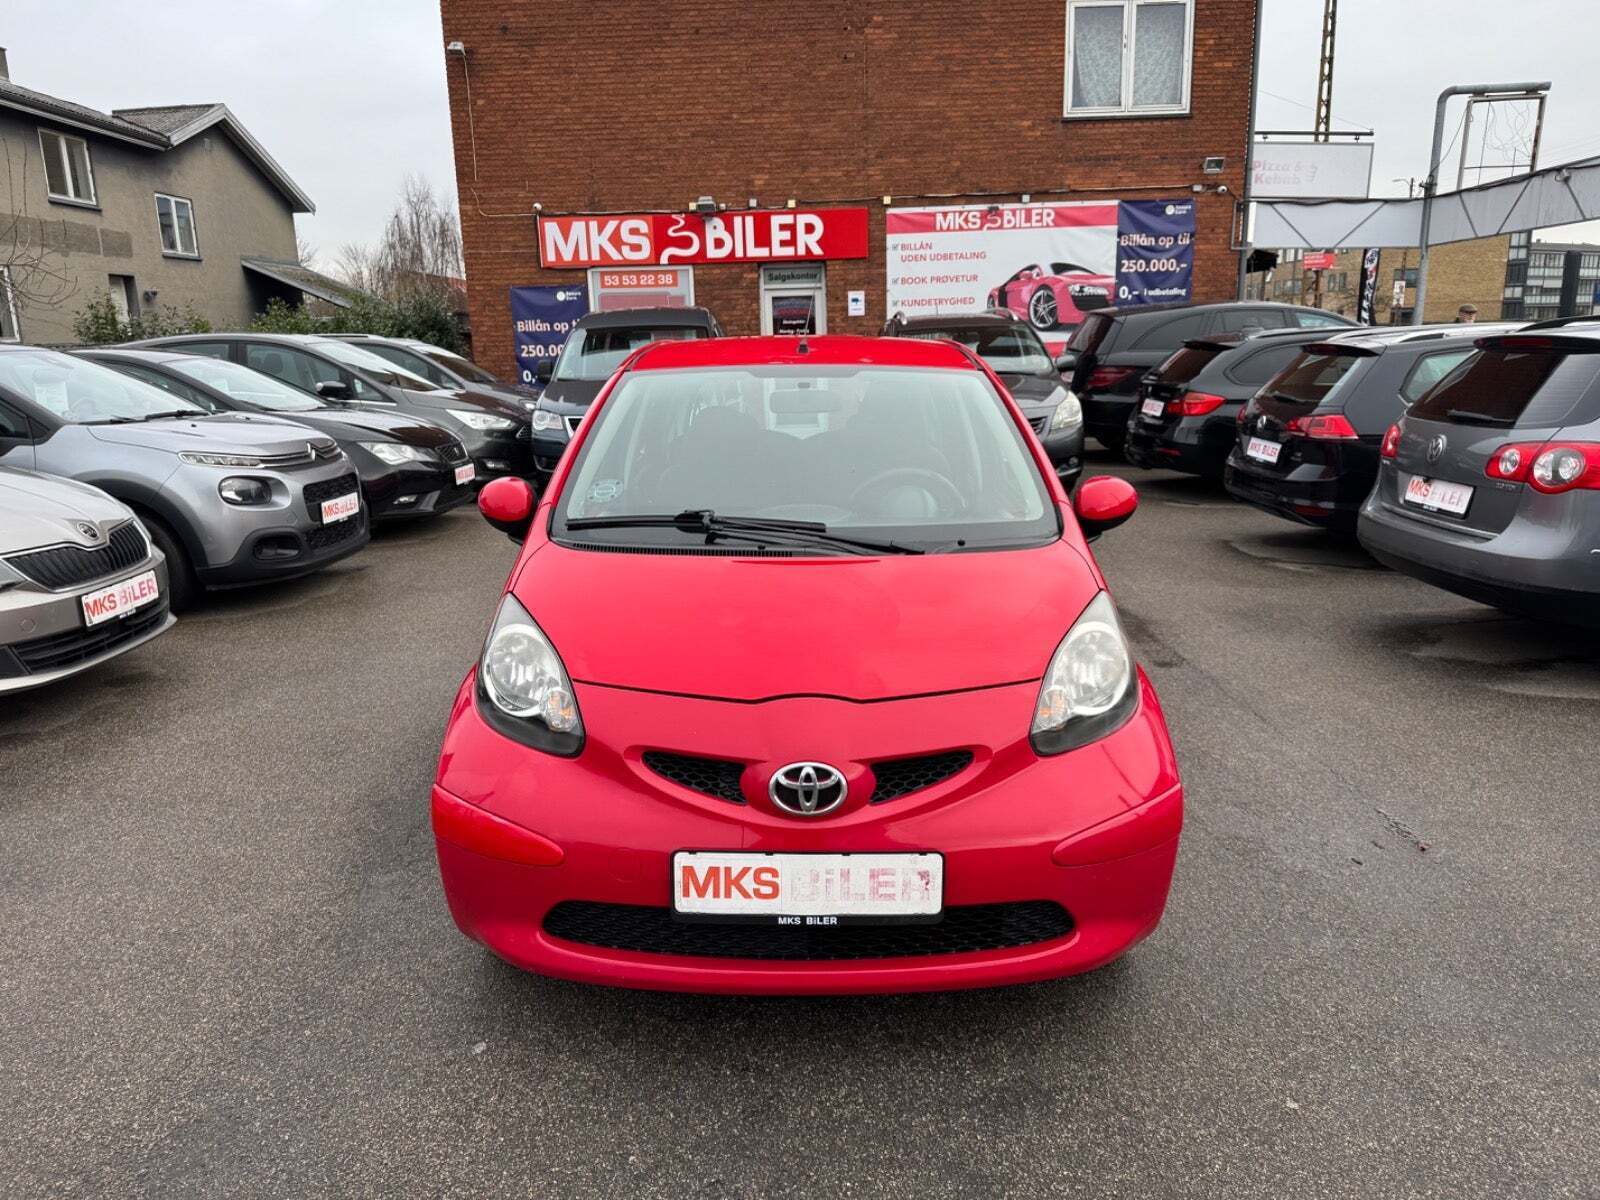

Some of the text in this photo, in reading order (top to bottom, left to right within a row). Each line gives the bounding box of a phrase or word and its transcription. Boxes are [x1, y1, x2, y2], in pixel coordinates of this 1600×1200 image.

[935, 206, 1055, 231] MKS BILER
[544, 213, 825, 262] MKS BILER
[1120, 232, 1190, 248] Billån op til
[900, 240, 933, 251] BILLÅN
[900, 250, 987, 262] UDEN UDBETALING
[1121, 258, 1188, 273] 250.000,-
[604, 273, 673, 286] 53 53 22 38
[900, 274, 979, 286] BOOK PRØVETUR
[900, 296, 976, 308] KUNDETRYGHED
[516, 319, 551, 333] Billån
[553, 322, 569, 334] op
[1408, 479, 1431, 498] MKS
[324, 502, 340, 519] MKS
[84, 593, 117, 623] MKS
[681, 865, 781, 900] MKS
[778, 916, 801, 925] MKS
